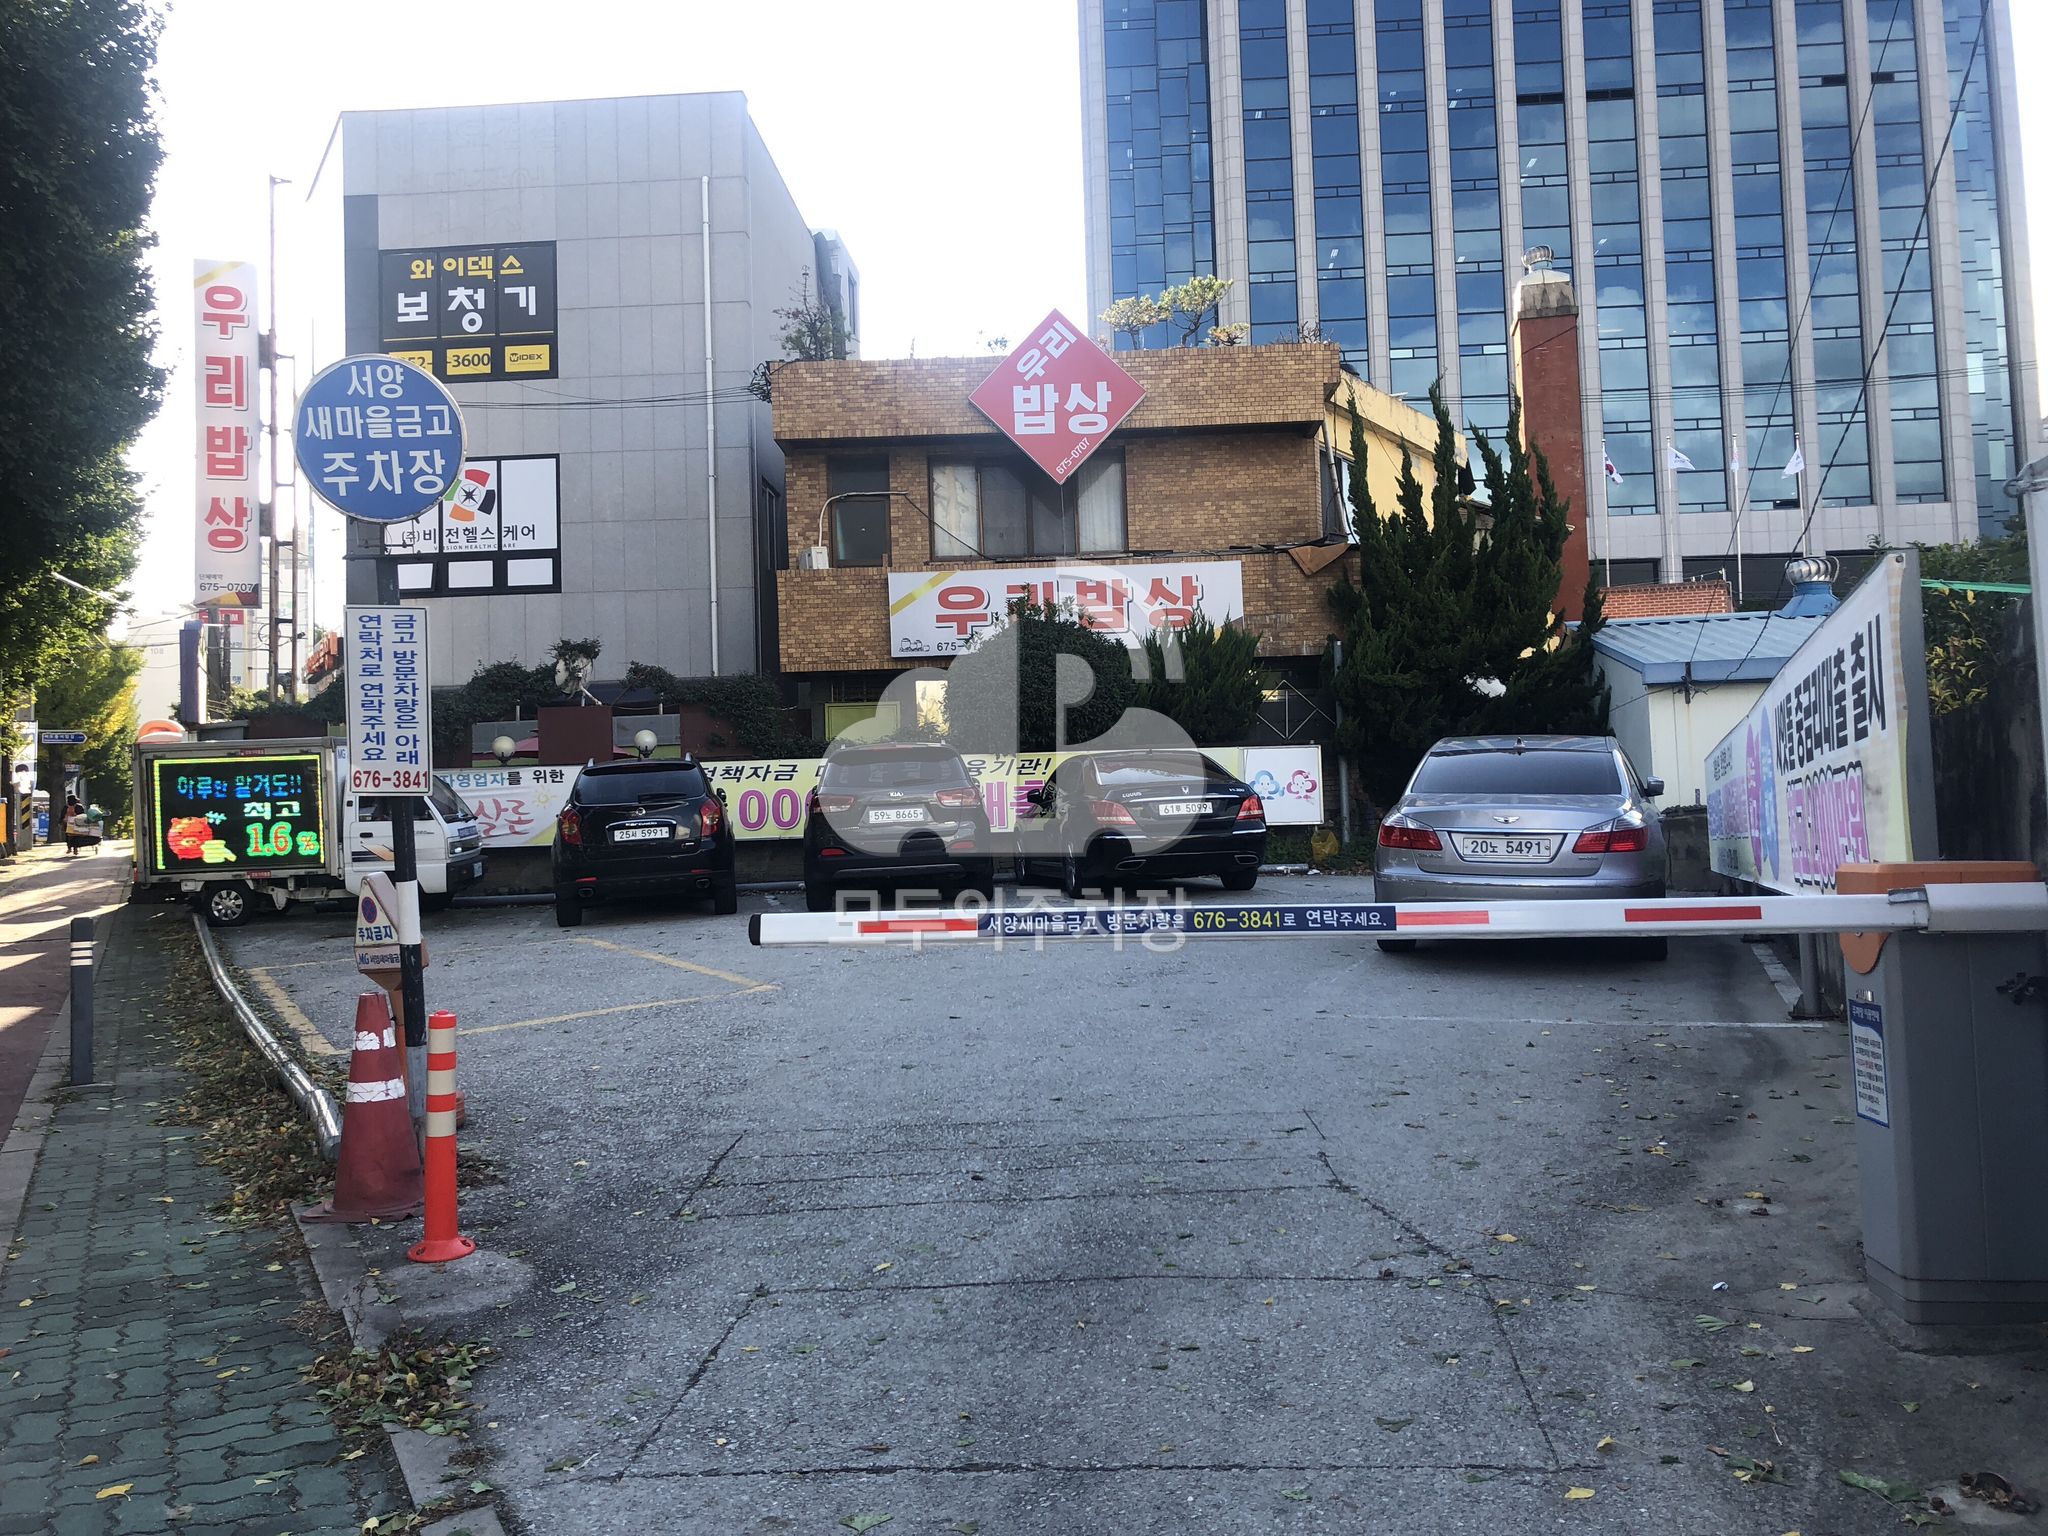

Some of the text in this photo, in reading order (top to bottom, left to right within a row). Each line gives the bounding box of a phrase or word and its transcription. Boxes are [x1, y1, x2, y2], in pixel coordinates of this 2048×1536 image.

[409, 254, 524, 280] 와이덱스
[397, 285, 537, 333] 보청기
[509, 352, 543, 363] WIDEX
[1016, 320, 1078, 382] 우리
[346, 363, 404, 399] 서양
[201, 284, 249, 550] 우리밥상
[1012, 381, 1112, 435] 밥상
[304, 405, 453, 440] 새마을금고
[1055, 436, 1091, 475] 675-0707
[322, 449, 446, 497] 주차장
[401, 524, 536, 544] (주)비전헬스케어
[199, 582, 254, 592] 675-0707
[358, 614, 387, 761] 연락처로 연락주세요
[391, 614, 420, 765] 금고 방문차량은 아래
[1774, 612, 1886, 777] 사잇돌 중금리대출 출시
[352, 770, 429, 788] 676-3841
[532, 769, 565, 784] 위한
[243, 801, 302, 820] 최고
[874, 809, 919, 820] 59노 8665
[1185, 803, 1208, 813] 5099
[641, 828, 664, 838] 5991
[1470, 840, 1541, 854] 20노 5491
[357, 925, 394, 942] 주차금지
[987, 908, 1388, 934] 서양새마을금고 방문차량은 676-3841로 연락주세요.
